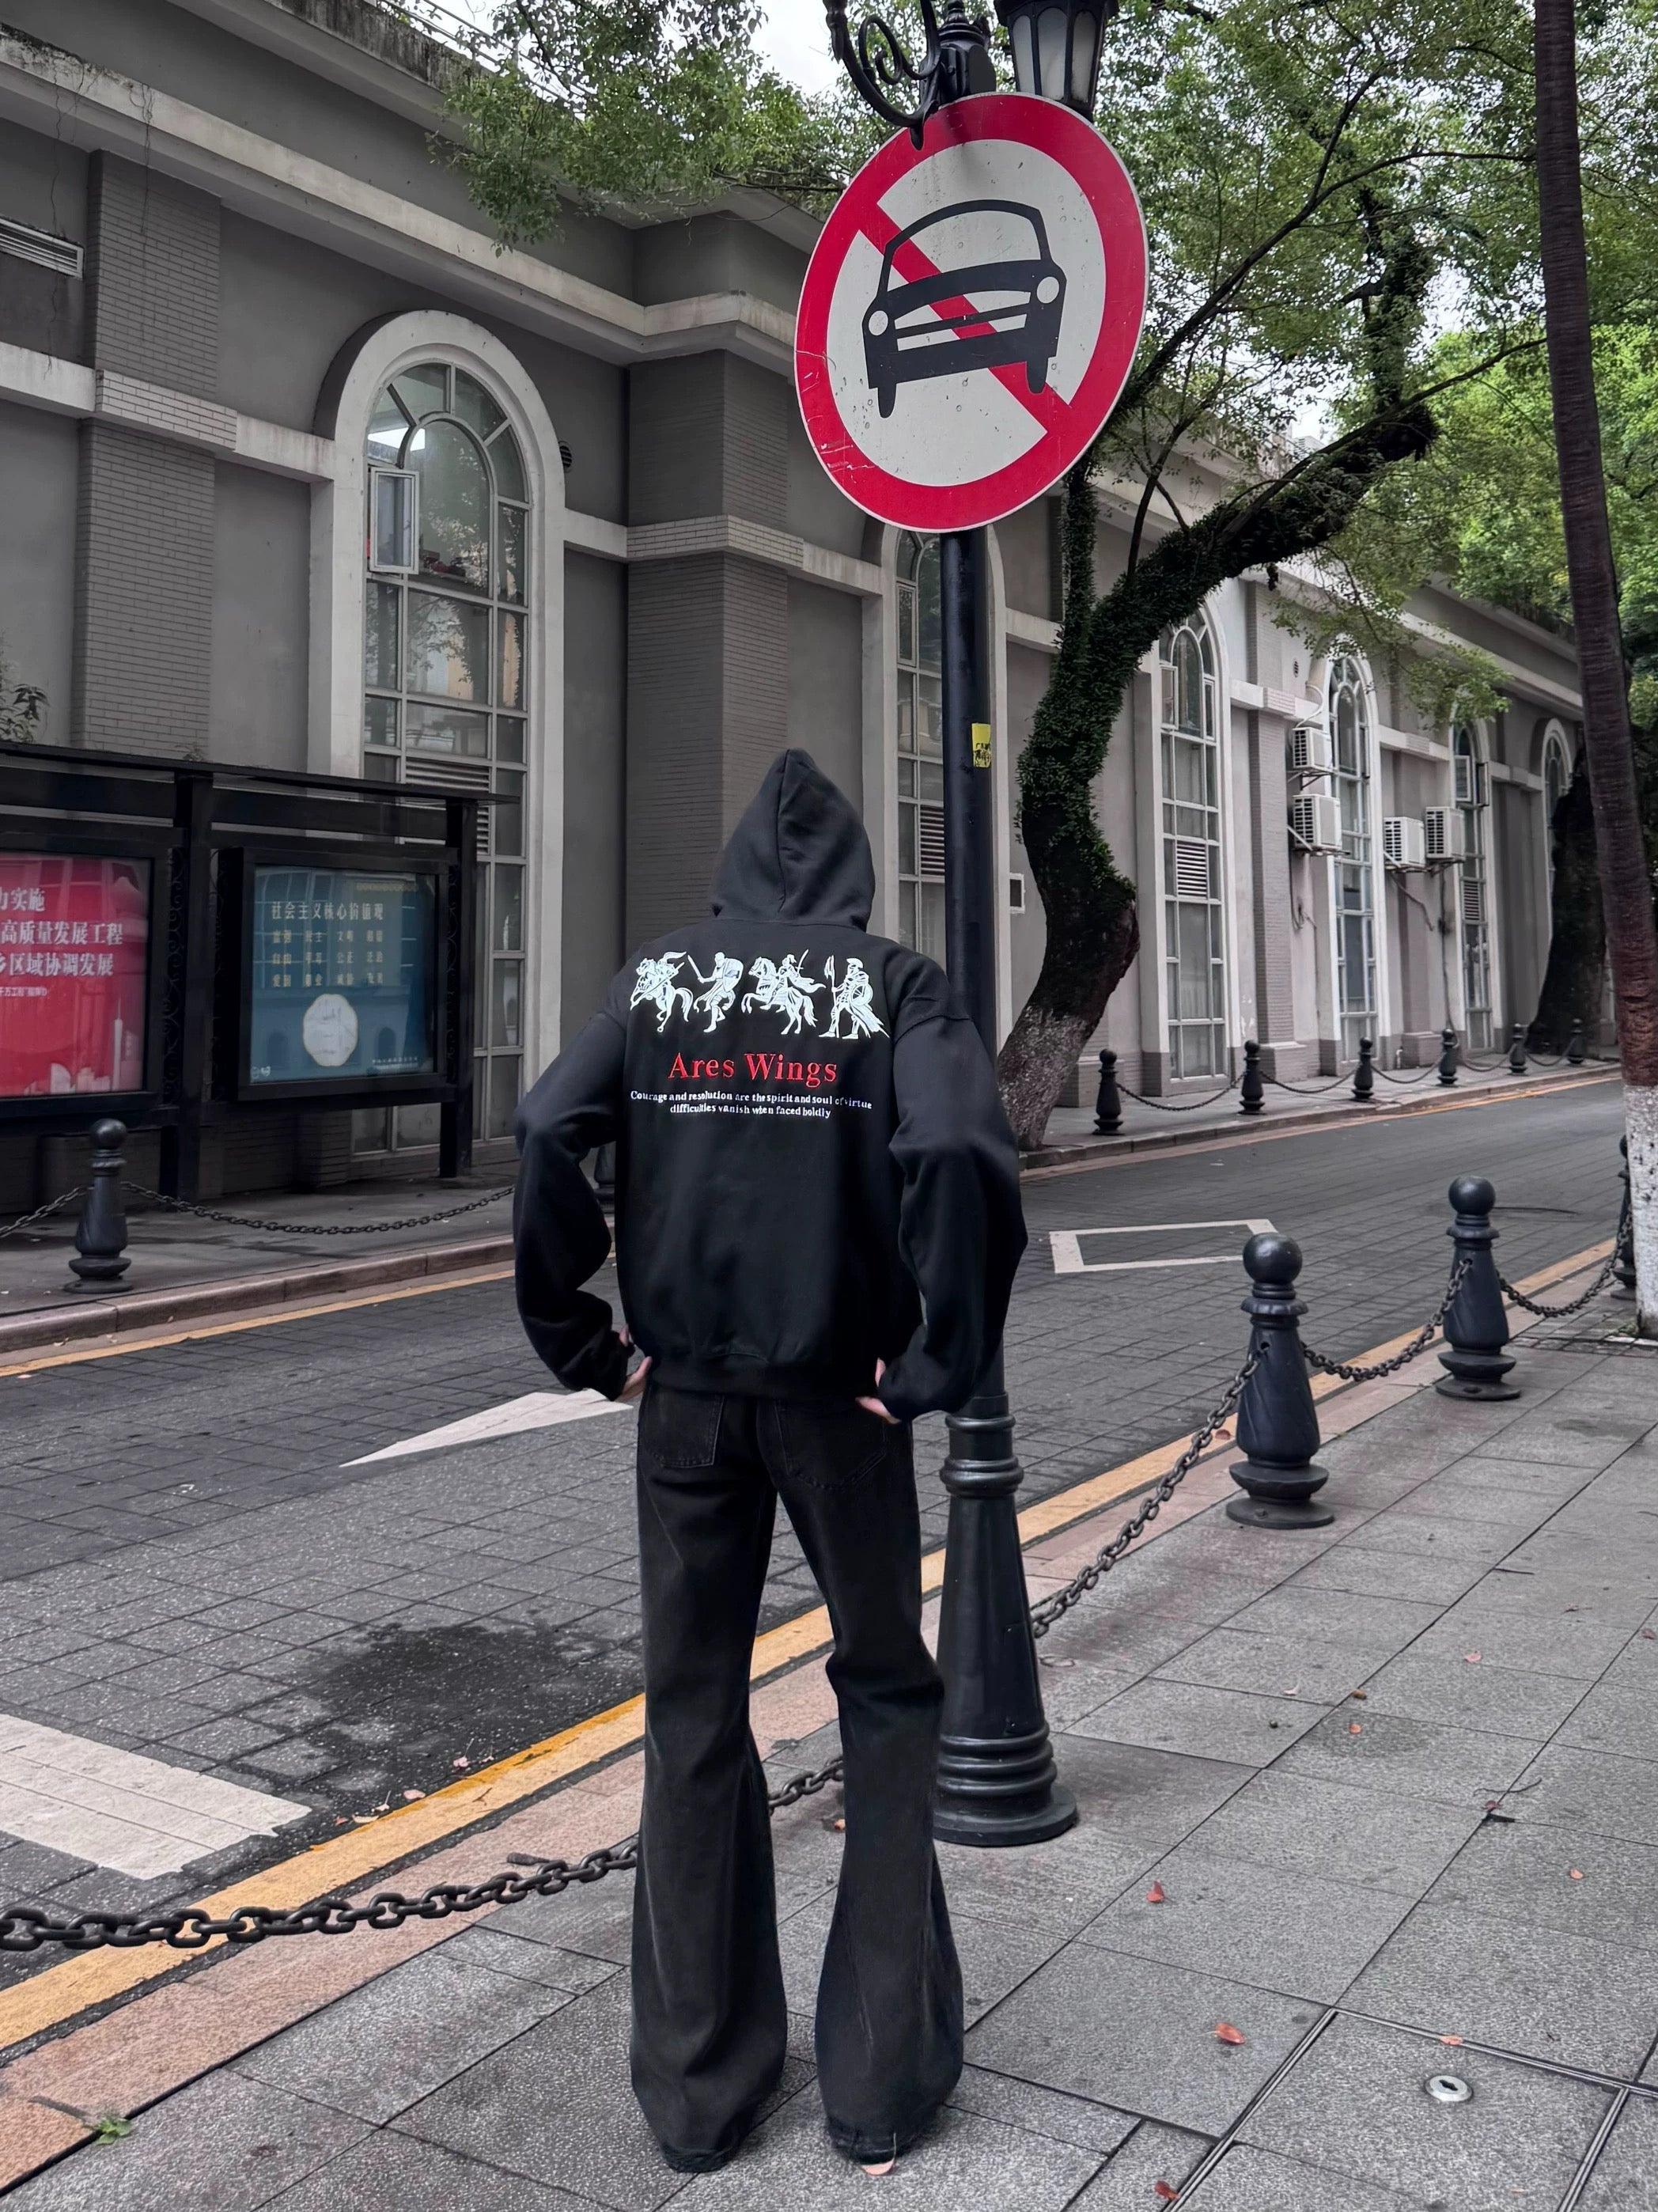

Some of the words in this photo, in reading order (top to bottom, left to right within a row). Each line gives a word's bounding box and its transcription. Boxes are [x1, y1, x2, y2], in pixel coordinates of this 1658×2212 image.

[1, 919, 123, 945] 高质量发展工程
[668, 1052, 735, 1080] Ares
[744, 1052, 838, 1088] Wings
[630, 1090, 668, 1103] Courage
[669, 1092, 687, 1100] and
[688, 1090, 732, 1100] resolution
[735, 1093, 750, 1101] are
[752, 1093, 766, 1102] the
[767, 1093, 793, 1104] spirit
[794, 1094, 811, 1104] and
[812, 1095, 833, 1104] soul
[845, 1097, 873, 1109] virtue
[670, 1103, 716, 1113] difficulties
[718, 1104, 750, 1114] vanish
[751, 1105, 774, 1115] when
[776, 1105, 801, 1115] faced
[802, 1106, 831, 1119] boldly
